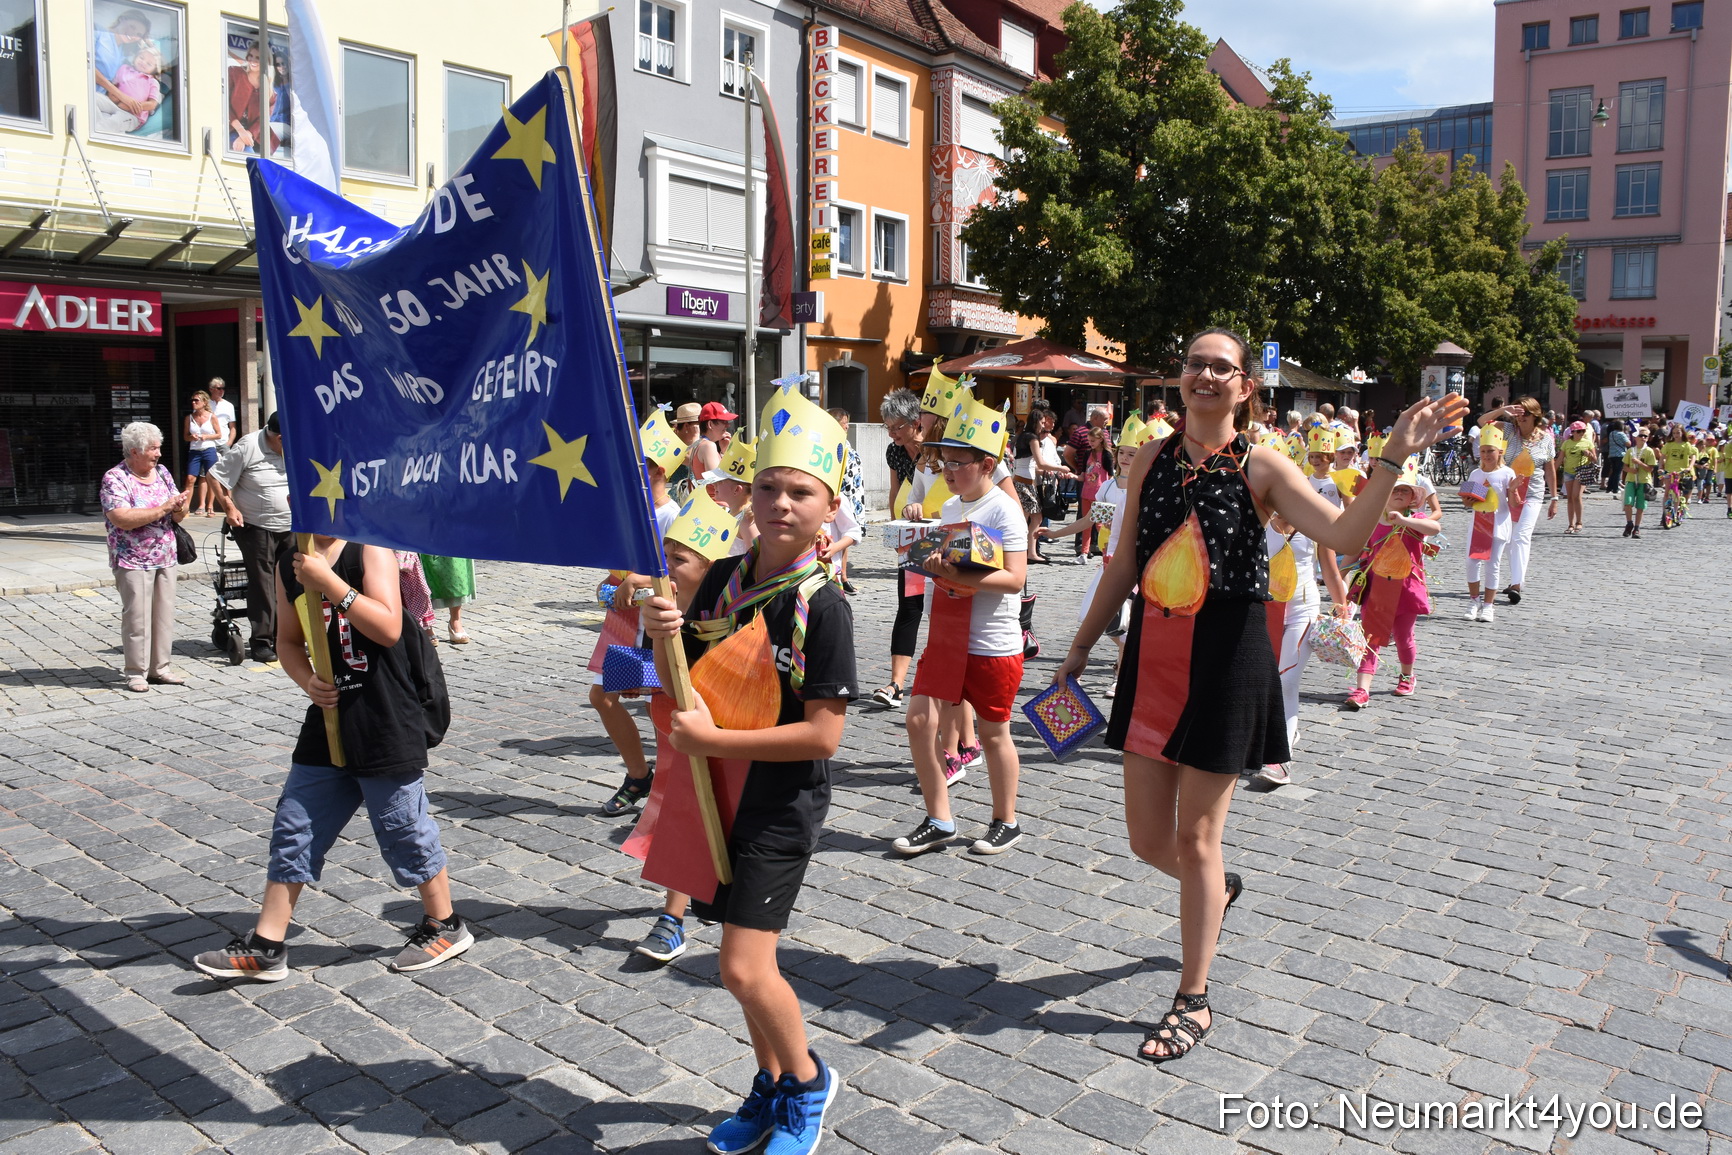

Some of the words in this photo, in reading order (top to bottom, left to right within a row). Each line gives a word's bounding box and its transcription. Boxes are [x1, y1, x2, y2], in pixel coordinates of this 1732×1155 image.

[814, 29, 829, 226] BÄCKEREI
[812, 234, 831, 249] café
[426, 253, 522, 310] JAHR
[12, 284, 156, 333] ADLER
[681, 290, 719, 315] liberty
[1573, 313, 1657, 331] Sparkasse
[1266, 345, 1277, 367] P
[314, 362, 364, 414] DAS
[384, 366, 445, 405] WIRD
[471, 350, 558, 402] GEFEIRT
[922, 393, 938, 408] 50
[1606, 402, 1648, 410] Grundschule
[956, 423, 976, 440] 50
[648, 440, 667, 458] 50
[1321, 443, 1331, 452] 50
[729, 460, 746, 476] 50
[808, 444, 833, 474] 50
[351, 459, 386, 498] IST
[401, 450, 440, 487] DOCH
[459, 444, 519, 484] KLAR
[688, 526, 712, 548] 50
[949, 537, 971, 550] RACING
